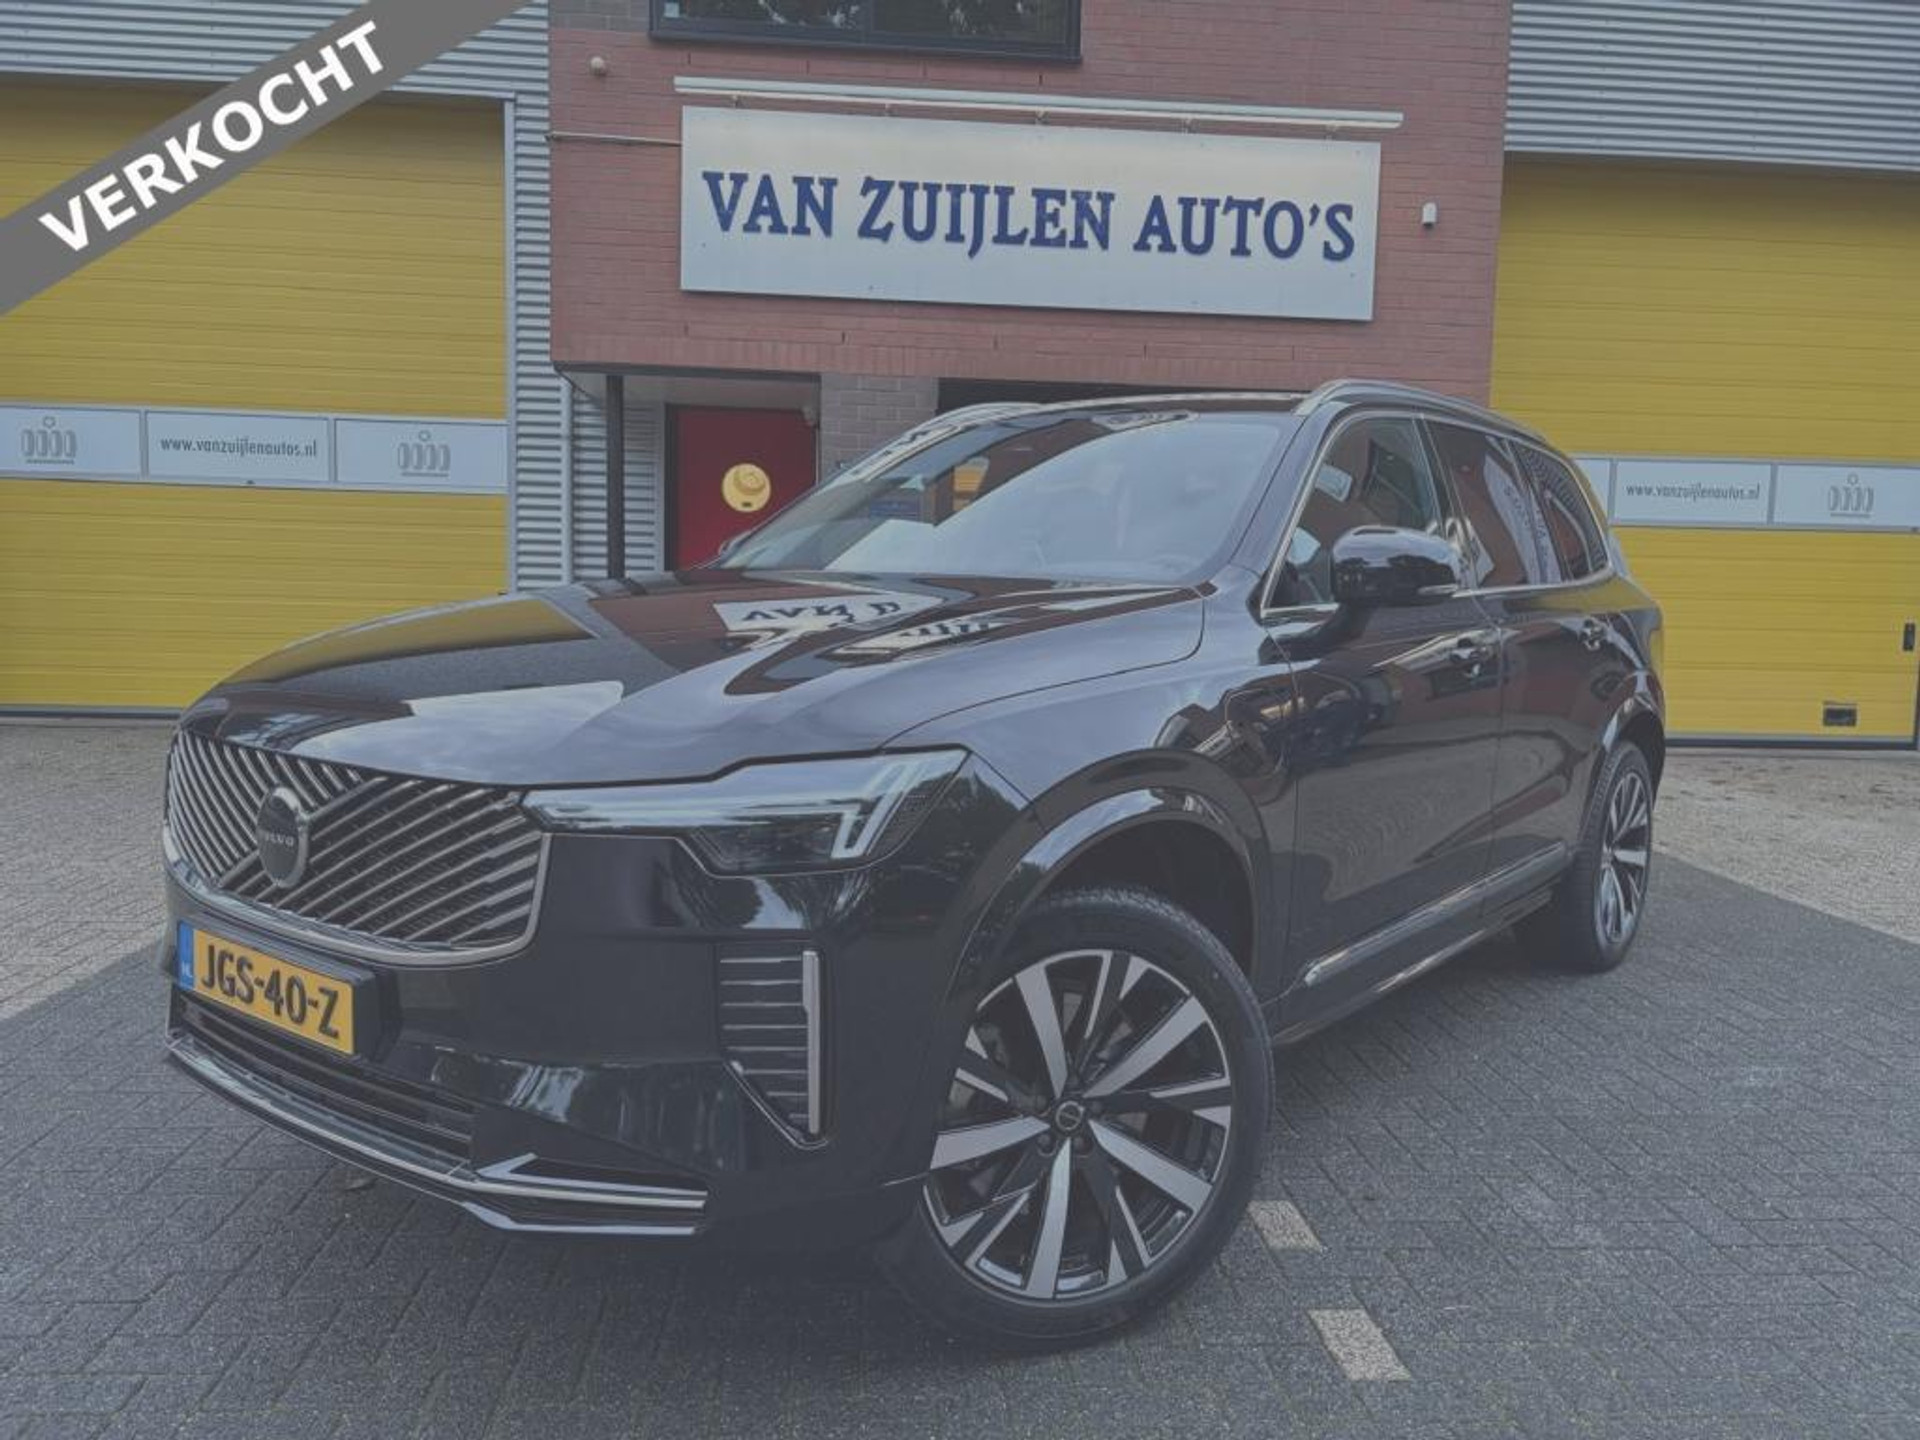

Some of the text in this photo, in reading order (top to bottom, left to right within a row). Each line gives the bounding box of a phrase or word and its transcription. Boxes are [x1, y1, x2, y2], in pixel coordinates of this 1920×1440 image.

[702, 170, 1355, 262] VAN ZUIJLEN AUTO'S
[160, 437, 317, 457] www.vanzuijlenautos.nl
[202, 945, 339, 1039] JGS-40-Z
